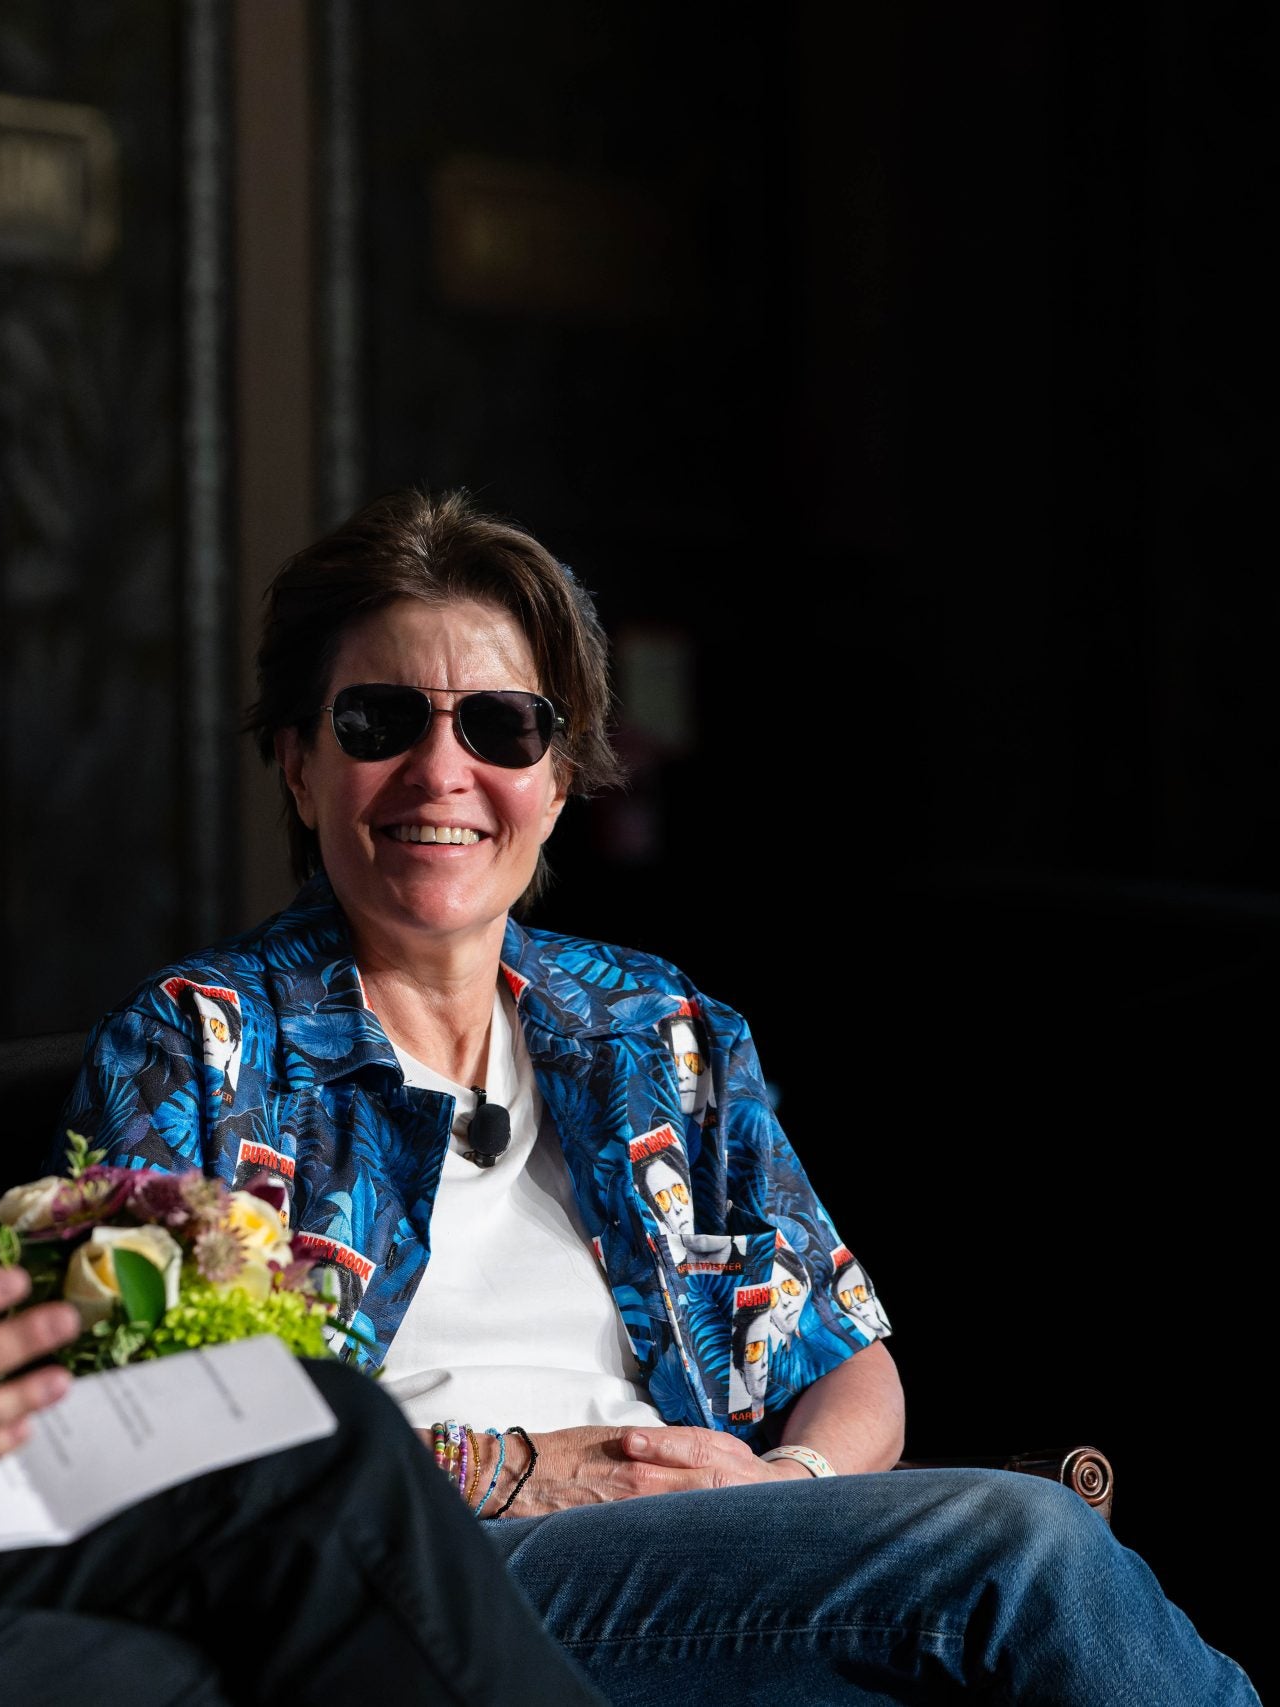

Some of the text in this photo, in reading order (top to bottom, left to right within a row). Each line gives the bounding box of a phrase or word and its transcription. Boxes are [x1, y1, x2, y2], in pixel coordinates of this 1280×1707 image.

[200, 986, 238, 1005] BOOK
[240, 1143, 279, 1170] BURN
[279, 1156, 295, 1180] BO
[629, 1140, 650, 1164] RN
[644, 1127, 677, 1154] BOOK
[335, 1245, 372, 1281] BOOK
[736, 1286, 770, 1309] BURN
